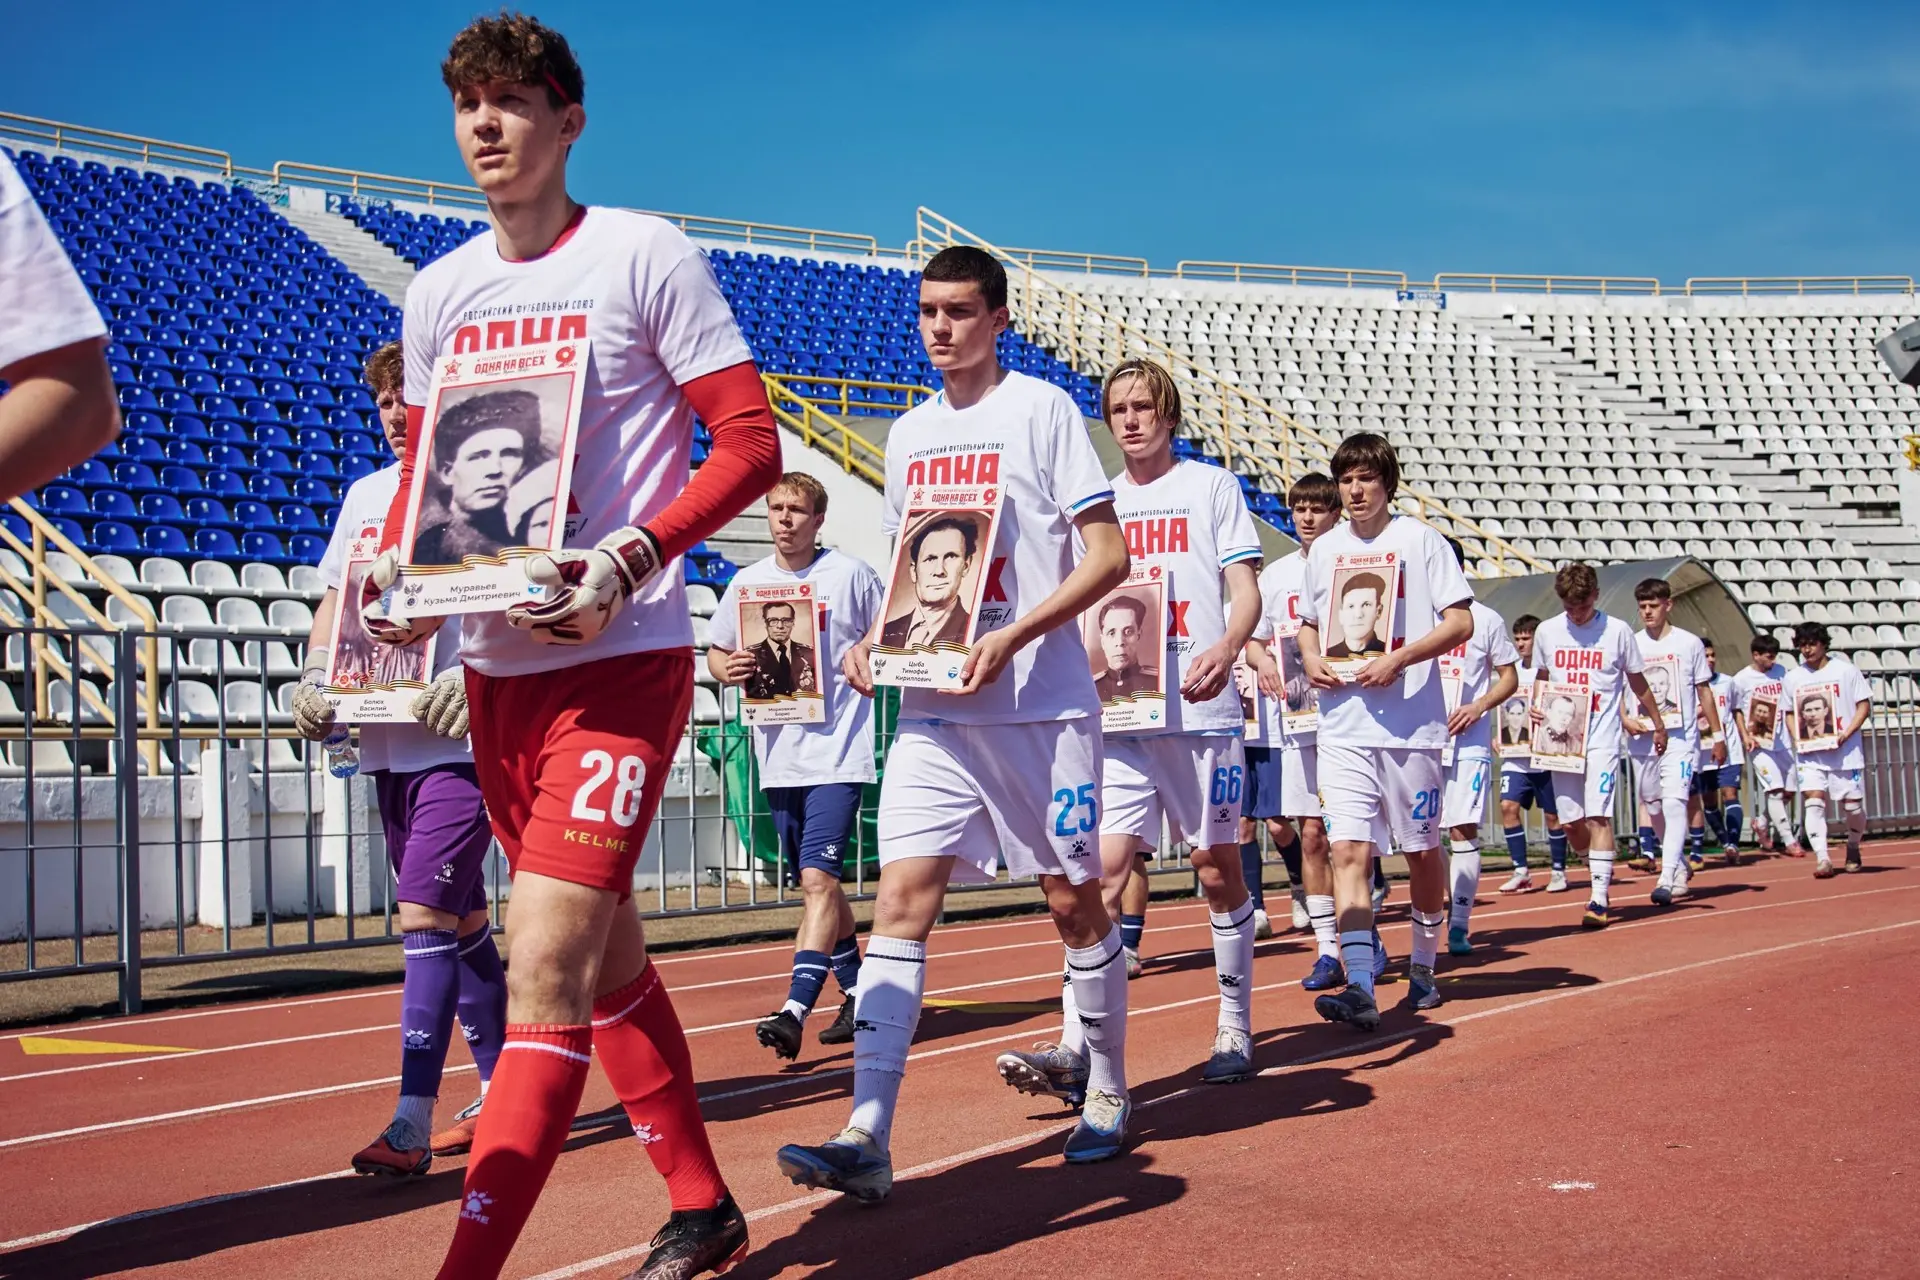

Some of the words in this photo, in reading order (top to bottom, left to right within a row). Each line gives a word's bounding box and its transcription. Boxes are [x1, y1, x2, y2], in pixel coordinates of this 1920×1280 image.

[329, 195, 341, 213] 2
[463, 304, 513, 321] РОССИЙСКИЙ
[516, 300, 569, 314] ФУТБОЛЬНЫЙ
[572, 299, 594, 310] СОЮЗ
[474, 359, 501, 375] ОДНА
[503, 358, 516, 370] НА
[518, 355, 546, 369] ВСЕХ
[914, 445, 947, 458] РОССИЙСКИЙ
[948, 442, 986, 452] ФУТБОЛЬНЫЙ
[987, 442, 1005, 450] СОЮЗ
[931, 493, 949, 503] ОДНА
[959, 493, 978, 502] ВСЕХ
[1140, 508, 1174, 516] ФУТБОЛЬНЫЙ
[1125, 517, 1188, 560] ДНА
[423, 596, 457, 606] Кузьма
[459, 591, 521, 603] Дмитриевич
[450, 583, 497, 594] Муравьев
[780, 588, 795, 596] ВСЕХ
[1555, 649, 1603, 670] ОДНА
[571, 749, 646, 828] 28
[1211, 765, 1242, 806] 66
[1054, 782, 1097, 837] 25
[1412, 788, 1440, 820] 20
[563, 828, 629, 852] KELME
[1067, 852, 1091, 860] KELME
